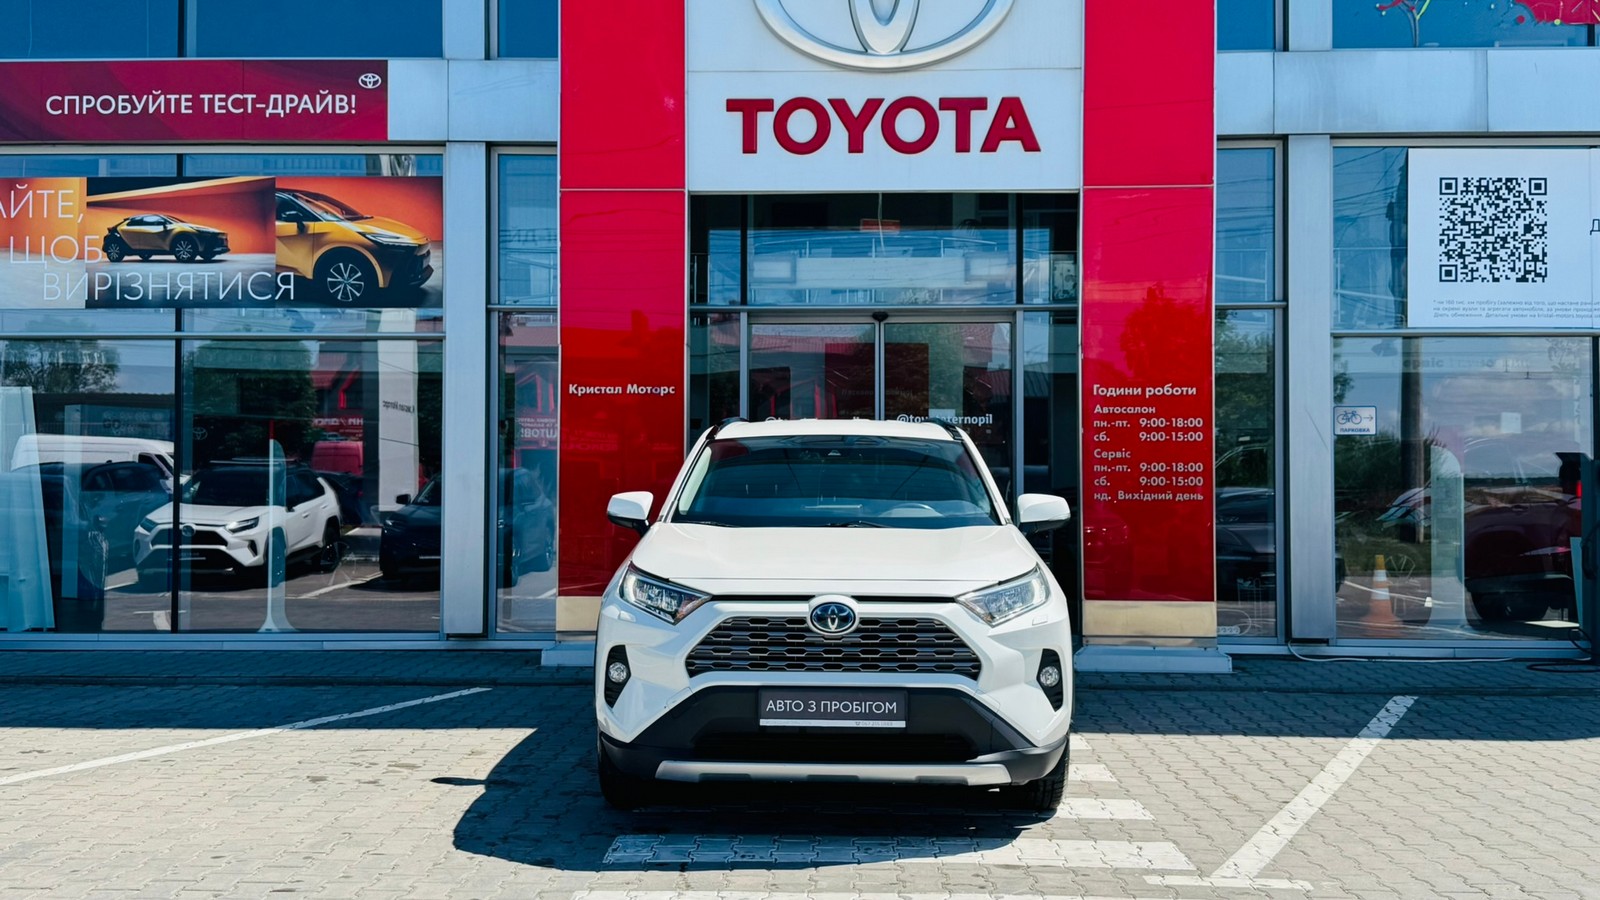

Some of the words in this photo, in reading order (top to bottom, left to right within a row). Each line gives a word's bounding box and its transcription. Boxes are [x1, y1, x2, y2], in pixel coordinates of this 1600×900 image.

[45, 90, 193, 115] СПРОБУЙТЕ
[199, 89, 356, 117] ТЕСТ-ДРАЙВ!
[726, 96, 1042, 155] TOYOTA
[0, 184, 84, 223] ЙТЕ,
[9, 235, 101, 269] ЩОБ
[43, 271, 295, 300] ВИРІЗНЯТИСЯ
[568, 384, 622, 396] Кристал
[626, 384, 676, 396] Моторс
[1093, 384, 1142, 397] Години
[1145, 383, 1197, 399] роботи
[1094, 404, 1156, 414] Автосалон
[1139, 417, 1204, 428] 9:00-18:00
[1093, 431, 1110, 441] сб.
[1139, 431, 1204, 441] 9:00-15:00
[1093, 448, 1131, 461] Сервіс
[1139, 462, 1204, 472] 9:00-18:00
[1093, 476, 1110, 486] сб.
[1139, 476, 1204, 486] 9:00-15:00
[1094, 492, 1111, 501] нд.
[1117, 490, 1173, 502] Вихідний
[1175, 492, 1204, 502] день
[766, 700, 804, 712] АВТО
[807, 700, 817, 713] З
[820, 701, 897, 714] ПРОБІГОМ
